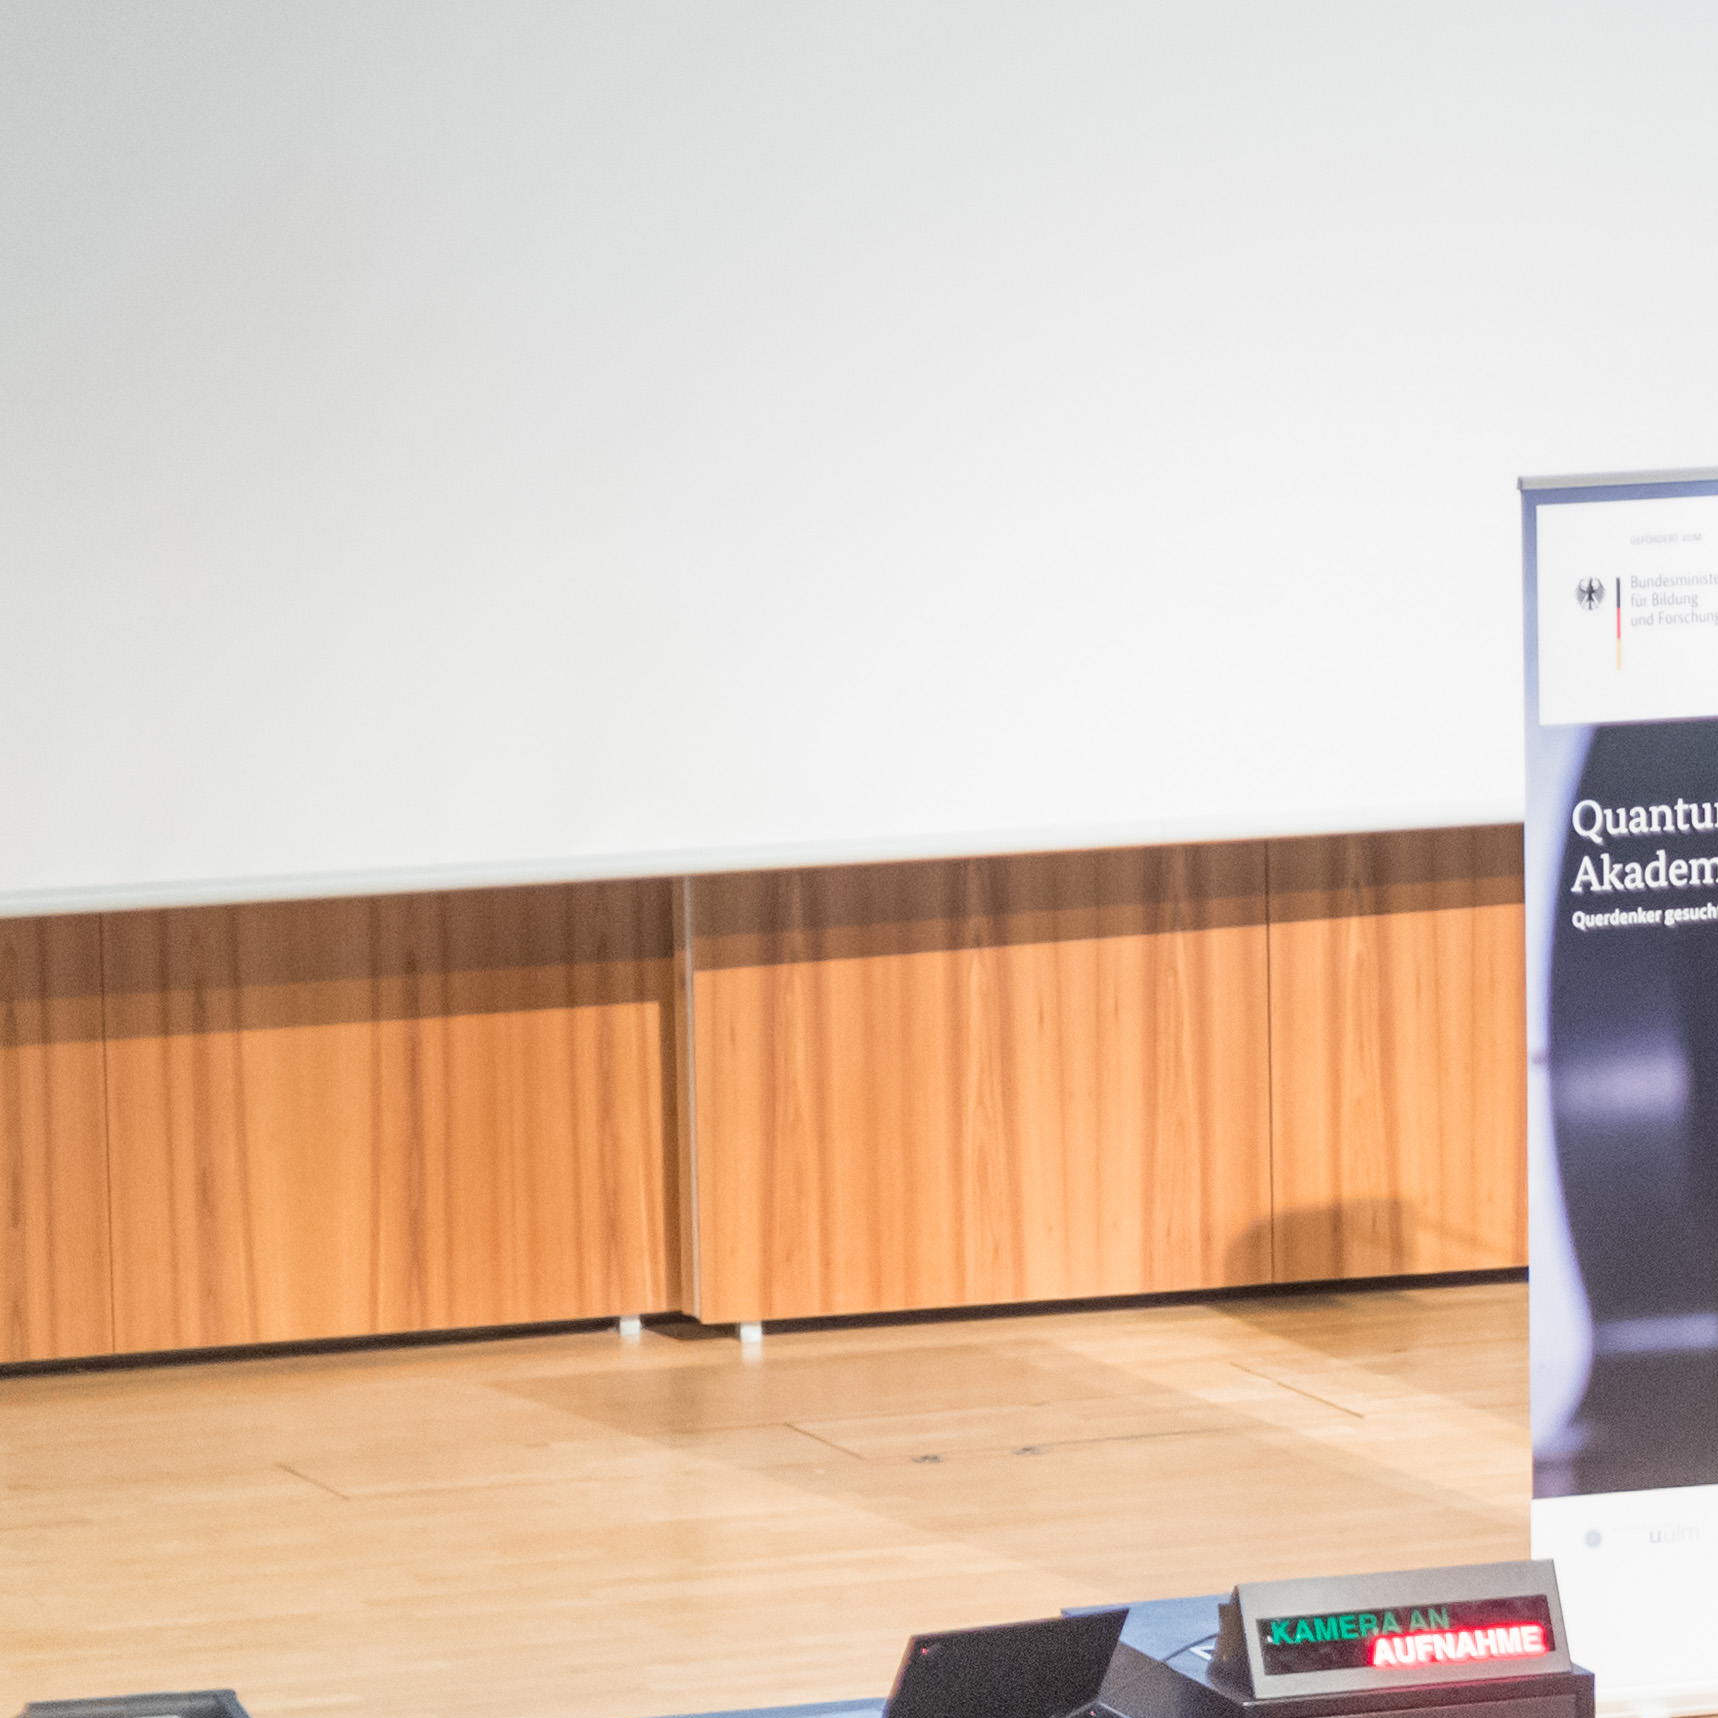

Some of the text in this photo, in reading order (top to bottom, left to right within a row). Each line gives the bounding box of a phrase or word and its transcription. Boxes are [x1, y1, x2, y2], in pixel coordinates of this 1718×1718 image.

[1630, 591, 1698, 608] für Bildung
[1630, 612, 1653, 627] und
[1571, 906, 1662, 931] Querdenker
[1270, 1607, 1450, 1646] KAMERA AN
[1373, 1624, 1546, 1667] AUFNAHME
